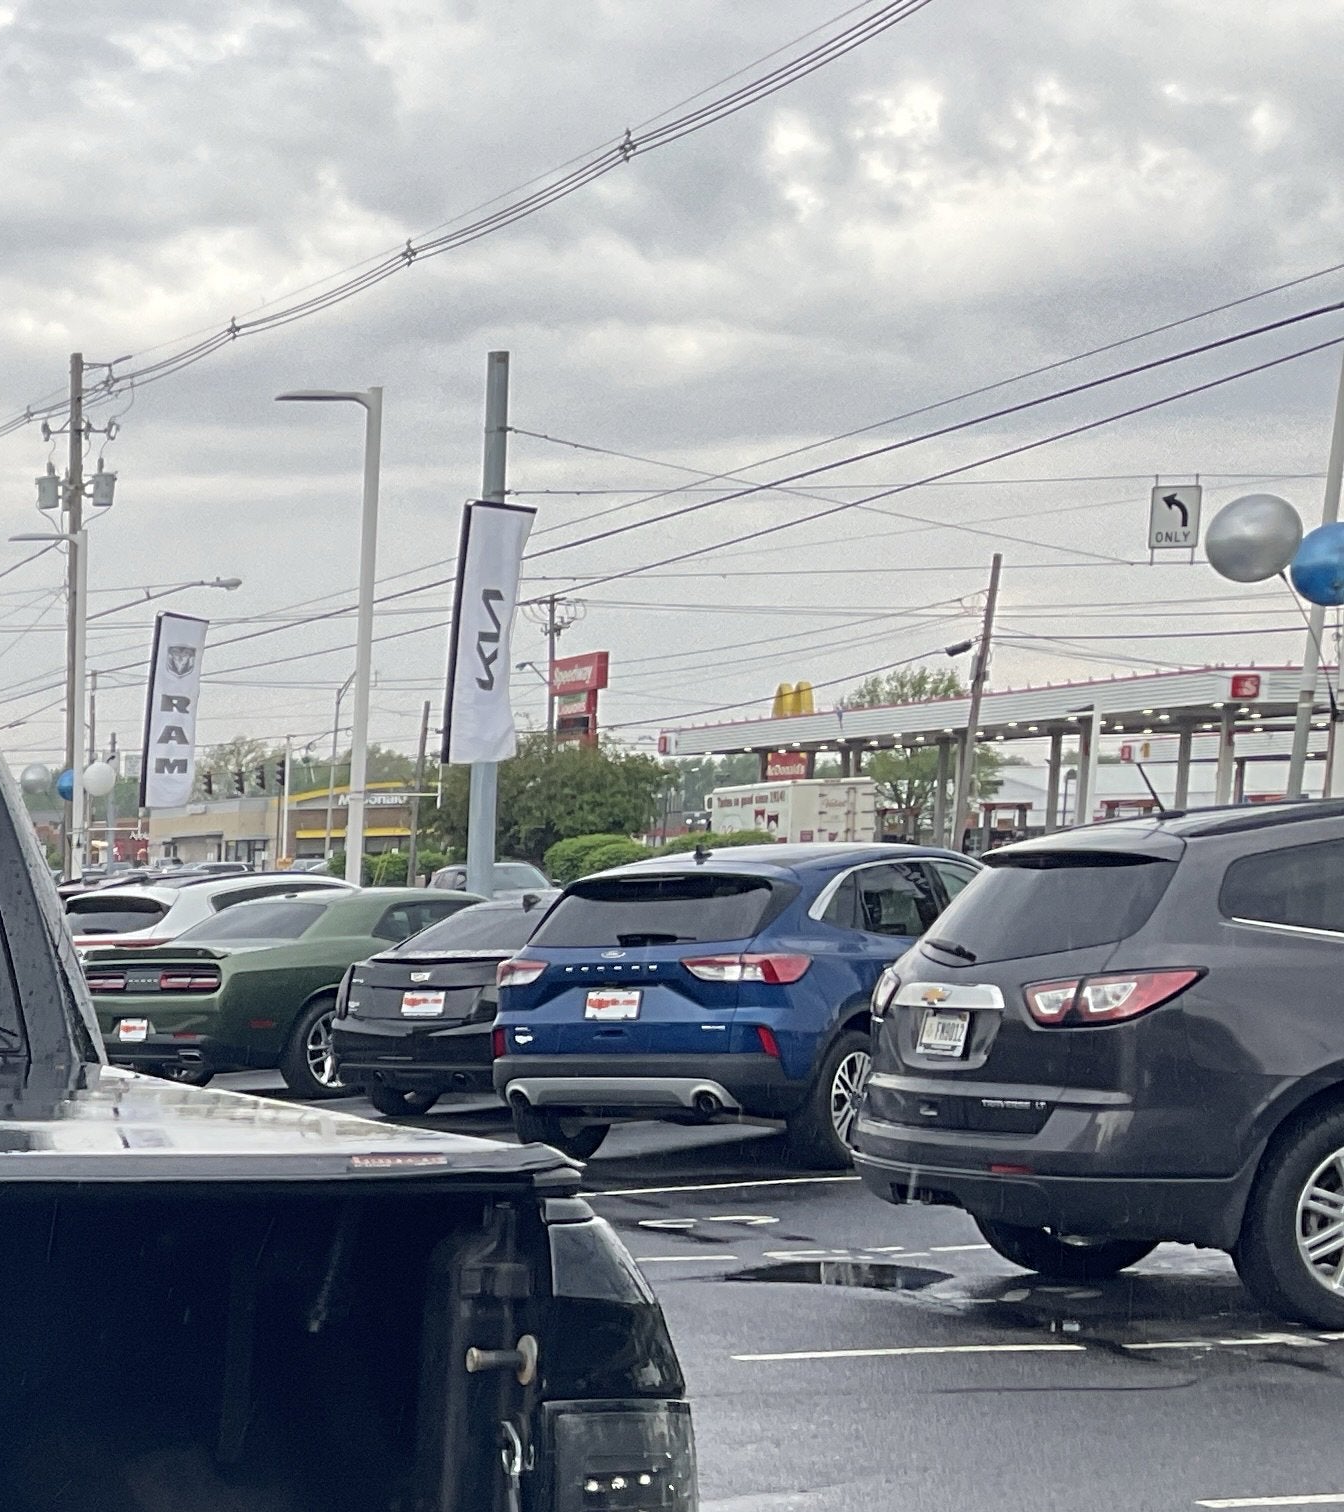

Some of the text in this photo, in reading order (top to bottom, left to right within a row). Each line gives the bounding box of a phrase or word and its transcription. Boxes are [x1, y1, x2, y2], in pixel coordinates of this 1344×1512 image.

[1155, 531, 1191, 543] ONLY
[475, 588, 505, 691] KIA
[154, 694, 191, 775] RAM
